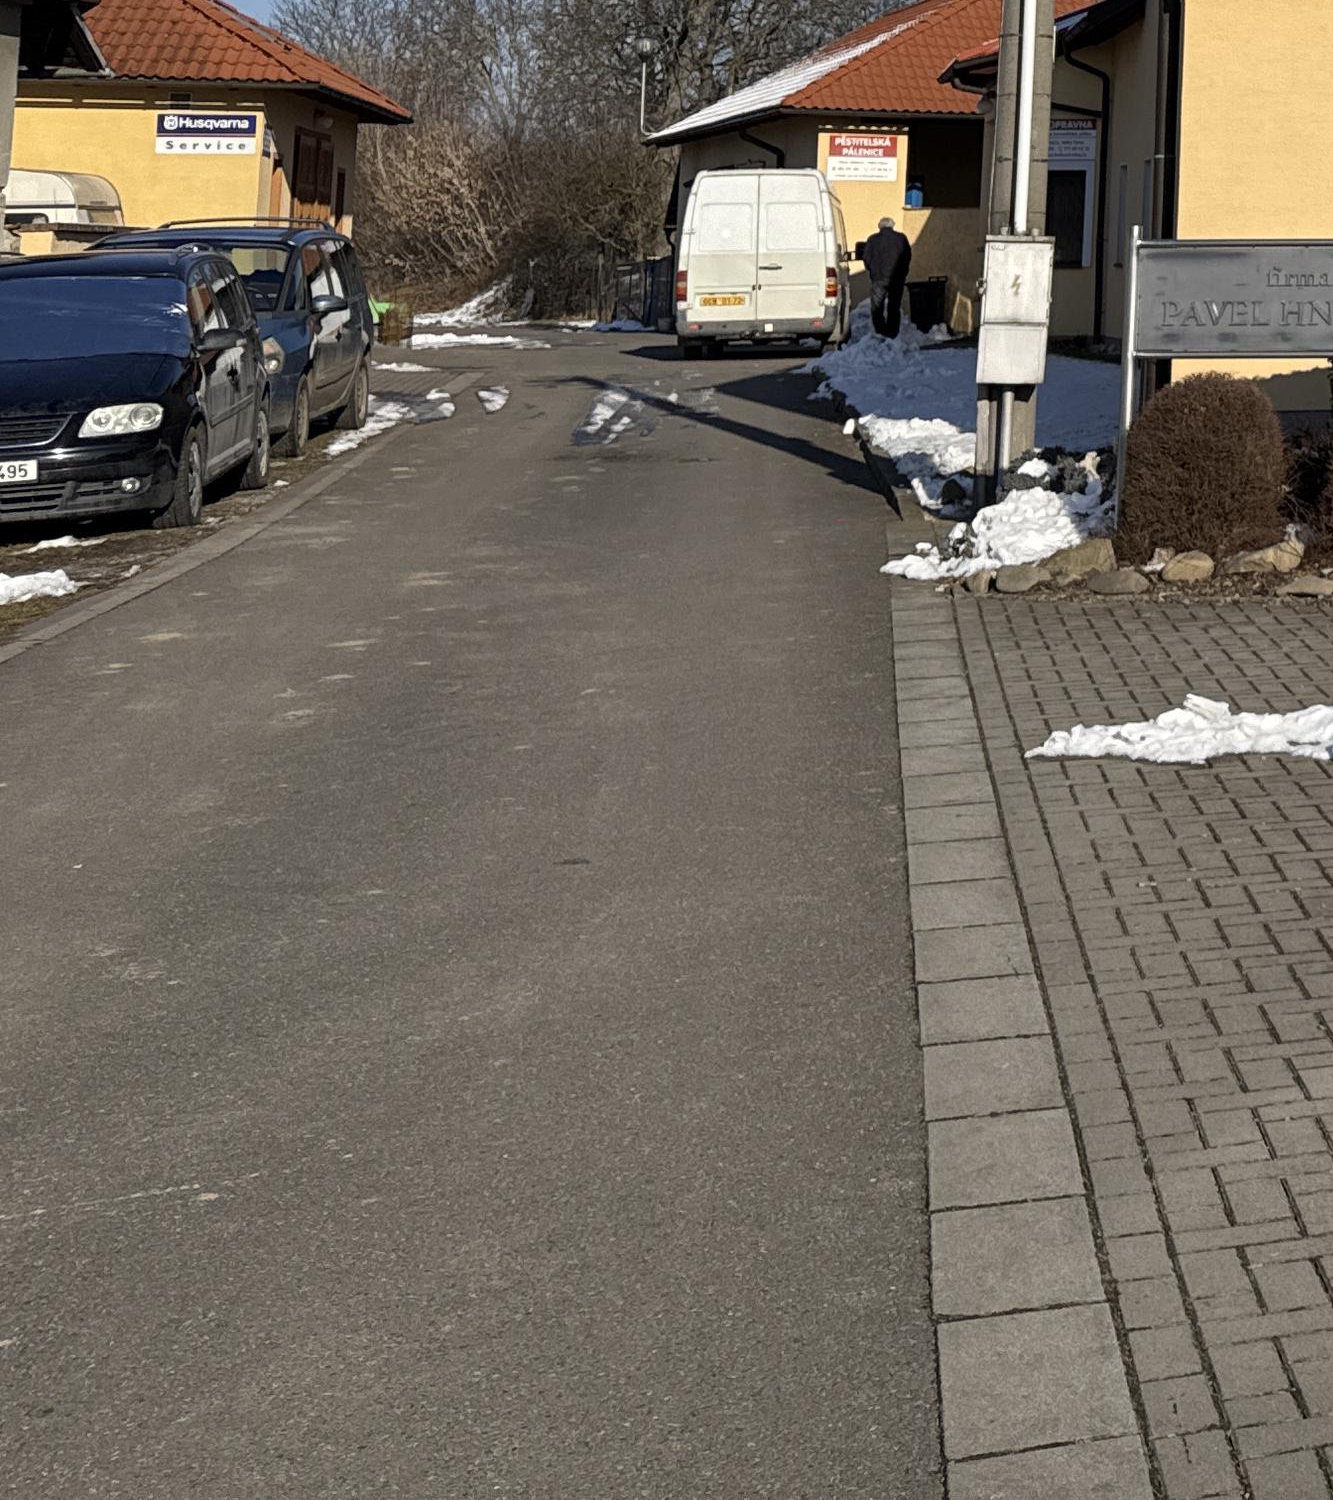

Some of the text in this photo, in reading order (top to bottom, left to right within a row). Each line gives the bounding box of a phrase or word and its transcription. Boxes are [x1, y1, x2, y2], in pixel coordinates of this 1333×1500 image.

[178, 116, 250, 130] Husqvarna
[165, 140, 247, 151] Service
[834, 135, 892, 147] PĚSTITELSKÁ
[842, 146, 885, 157] PÁLENICE
[1265, 266, 1333, 289] firma
[1160, 299, 1270, 328] PAVEL
